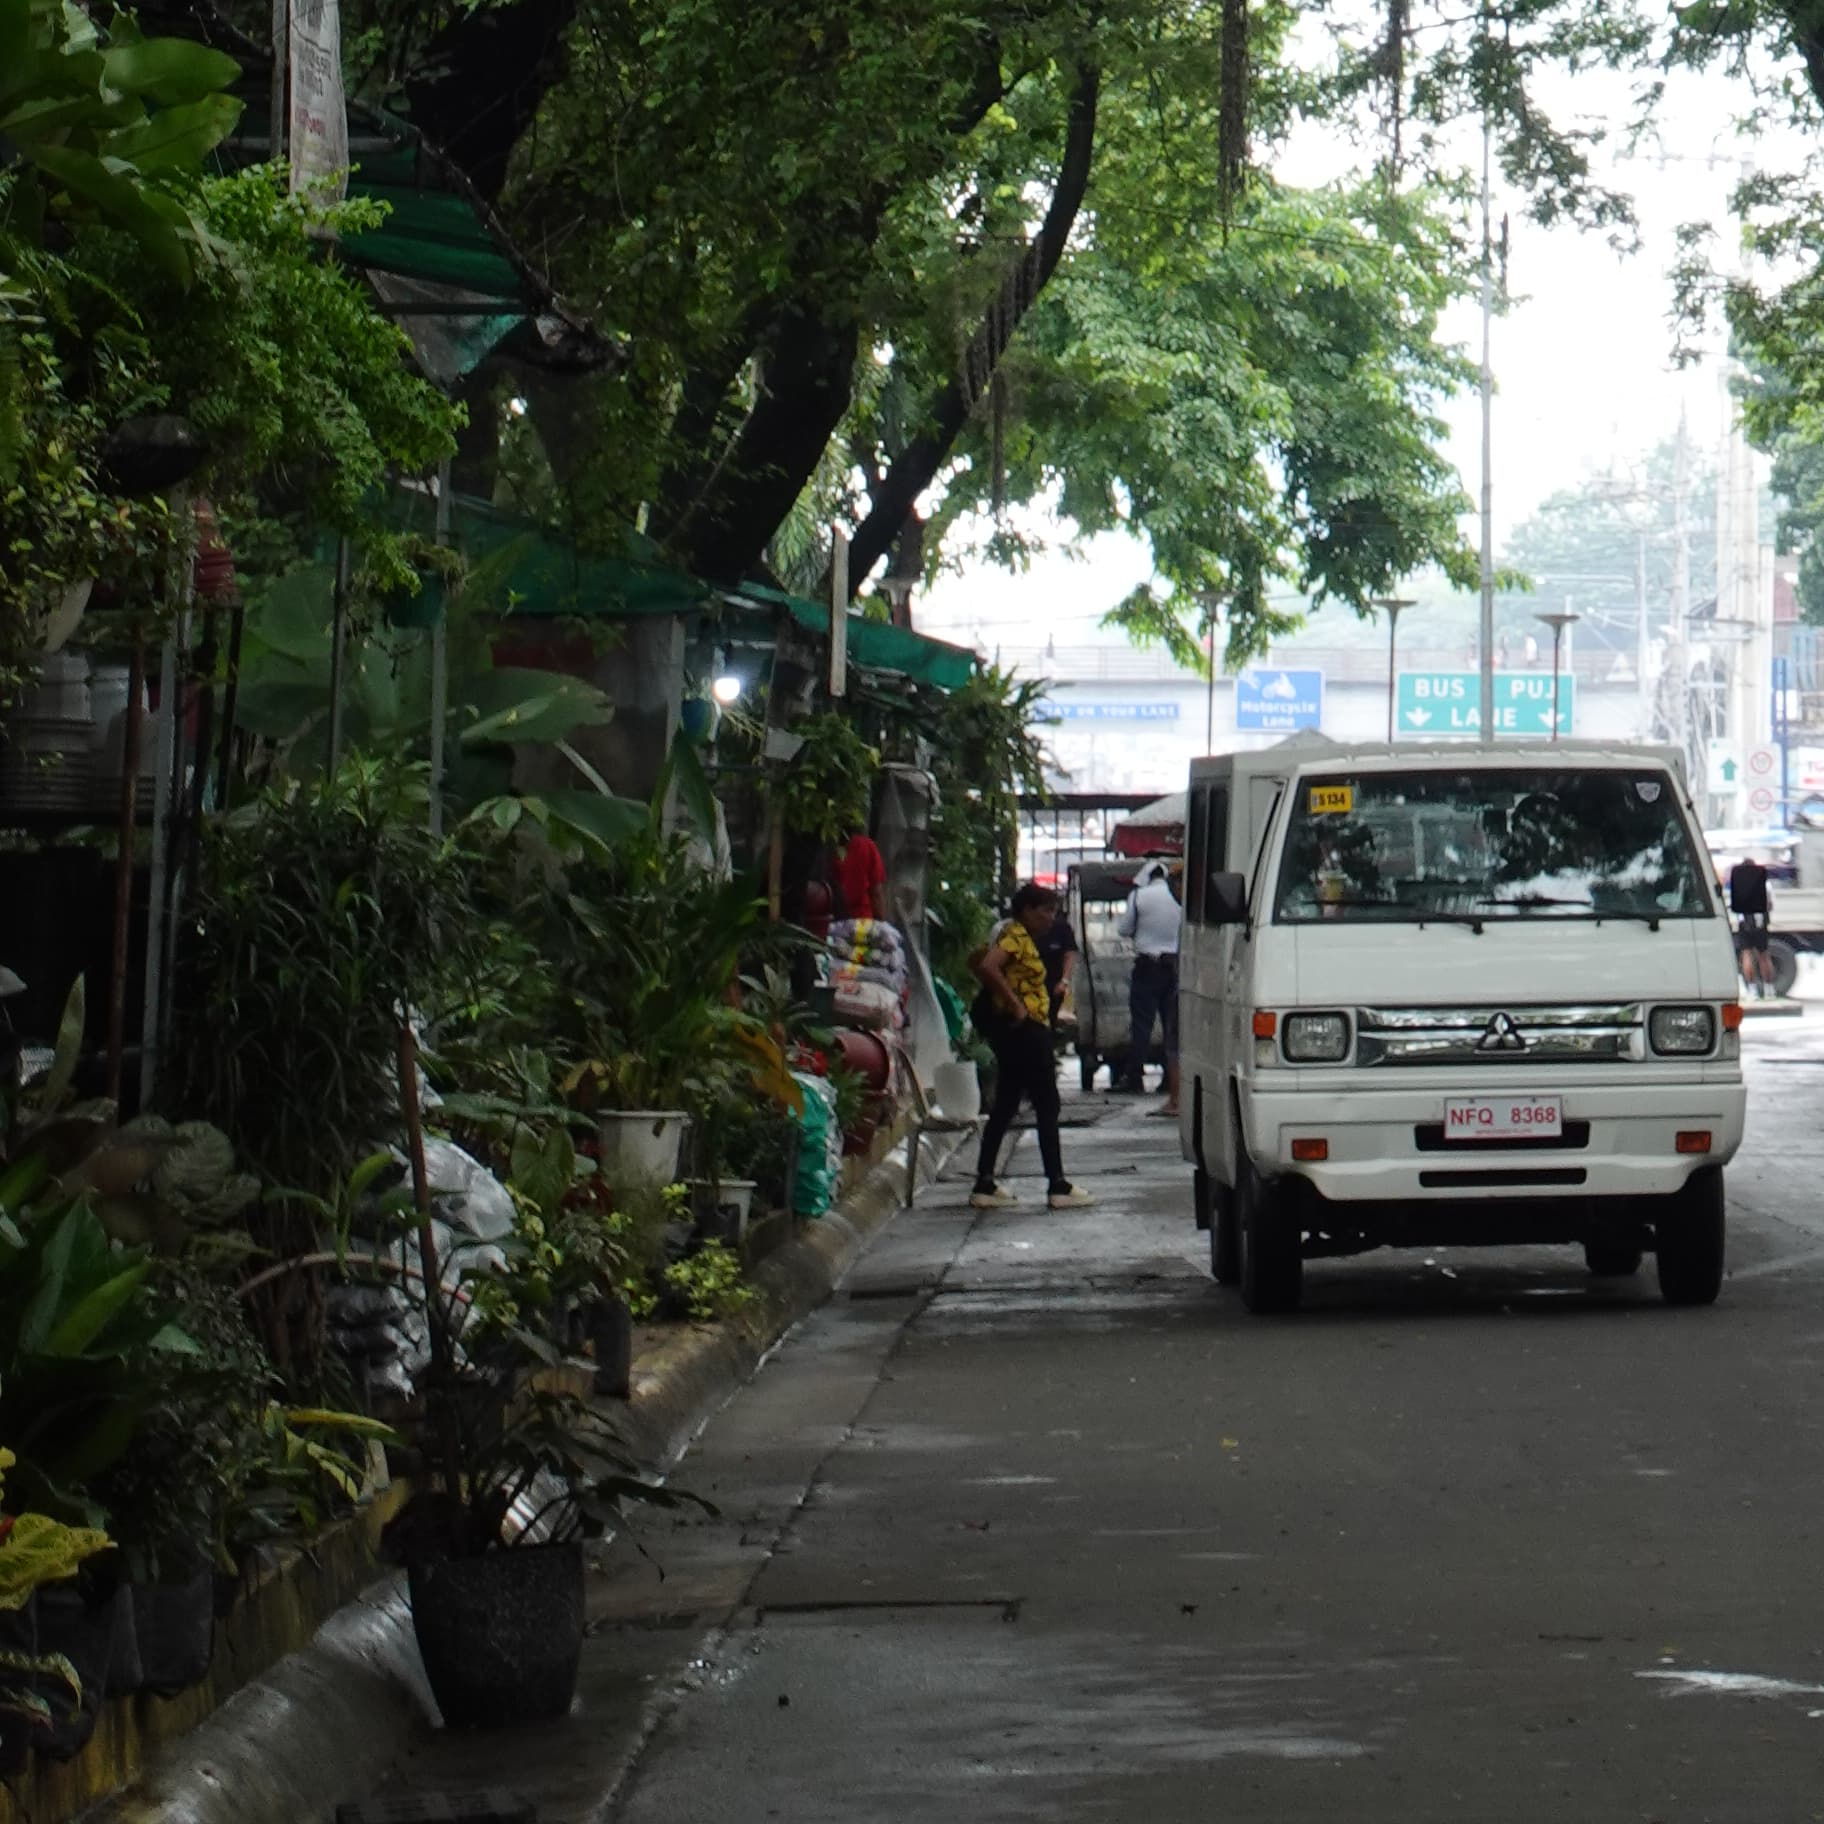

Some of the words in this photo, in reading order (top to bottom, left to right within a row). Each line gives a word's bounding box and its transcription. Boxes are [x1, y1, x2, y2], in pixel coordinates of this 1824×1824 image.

[1414, 677, 1466, 699] BUS
[1240, 700, 1317, 715] Motorcycle
[1450, 1107, 1494, 1125] NFQ
[1510, 1106, 1556, 1125] 8368
